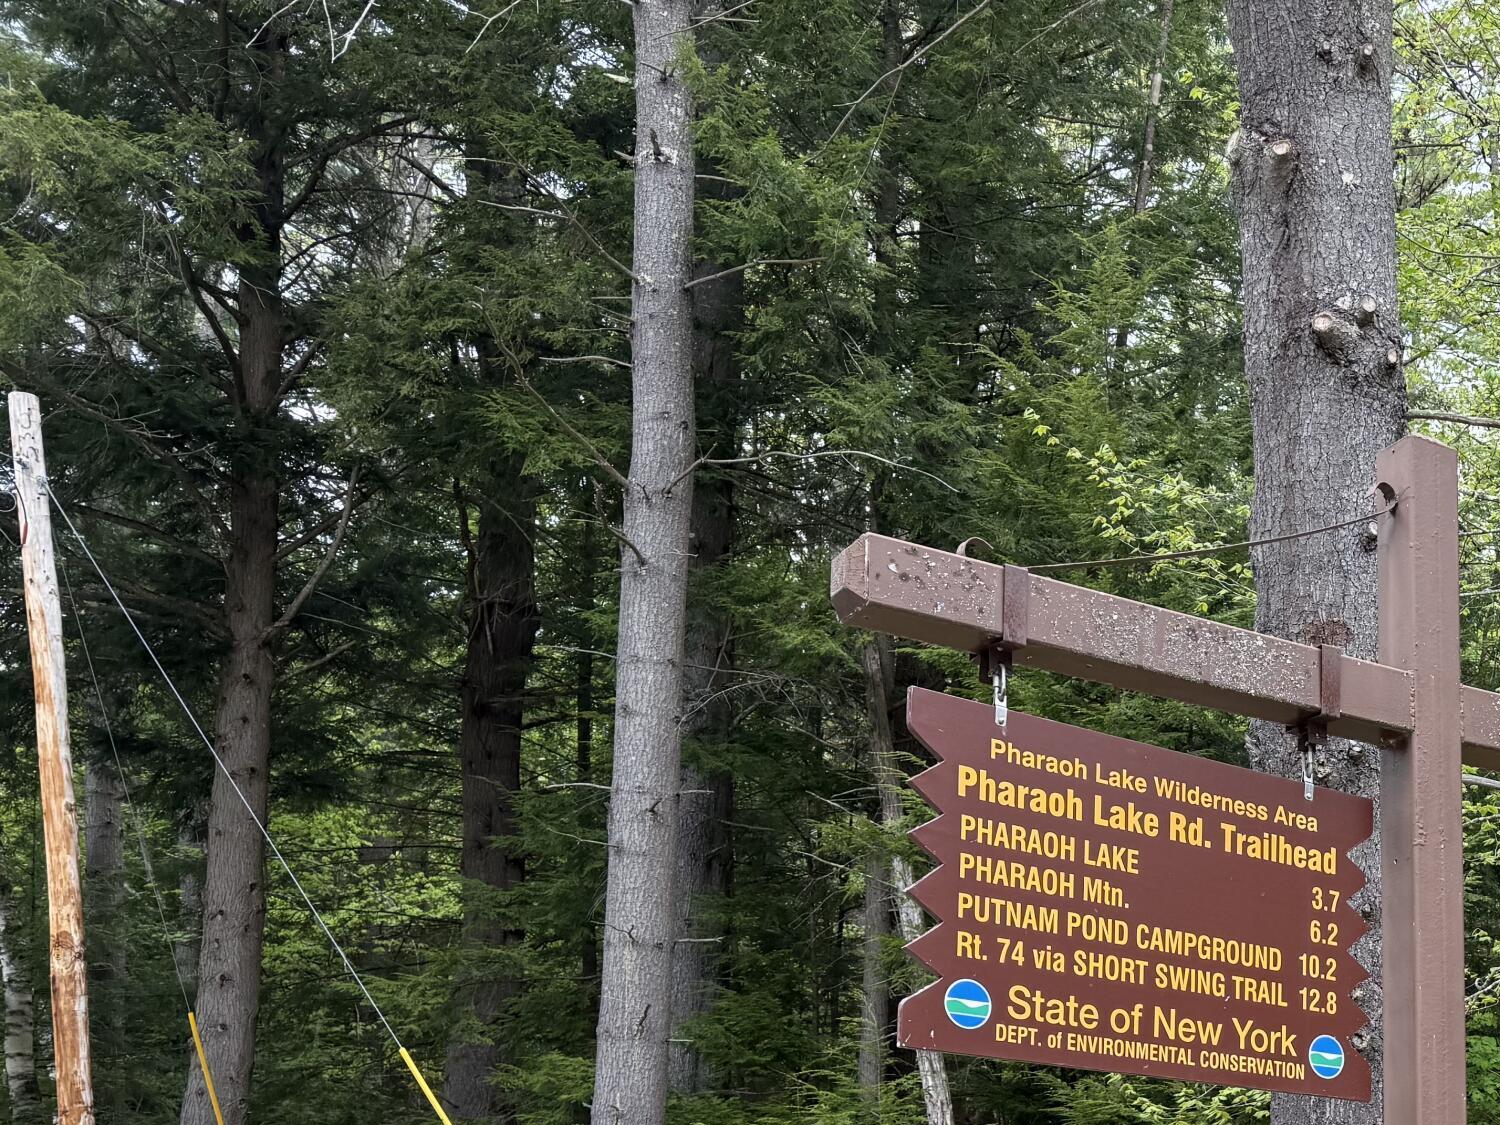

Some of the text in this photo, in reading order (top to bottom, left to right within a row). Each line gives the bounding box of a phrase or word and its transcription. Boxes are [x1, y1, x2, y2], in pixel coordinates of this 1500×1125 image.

[957, 764, 1337, 875] Pharaoh Lake Rd. Trailhead
[990, 737, 1318, 833] Pharaoh Lake Wilderness Area
[959, 852, 1339, 947] PHARAOH Mtn. 6.2
[960, 813, 1340, 913] PHARAOH LAKE 3.7
[956, 930, 1337, 1015] Rt. 74 via SHORT SWING TRAIL 12.8
[957, 891, 1337, 982] PUTNAM POND CAMPGROUND 10.2
[995, 1023, 1305, 1081] DEPT. of ENVIRONMENTAL CONSERVATION
[1007, 984, 1298, 1057] State of New York
